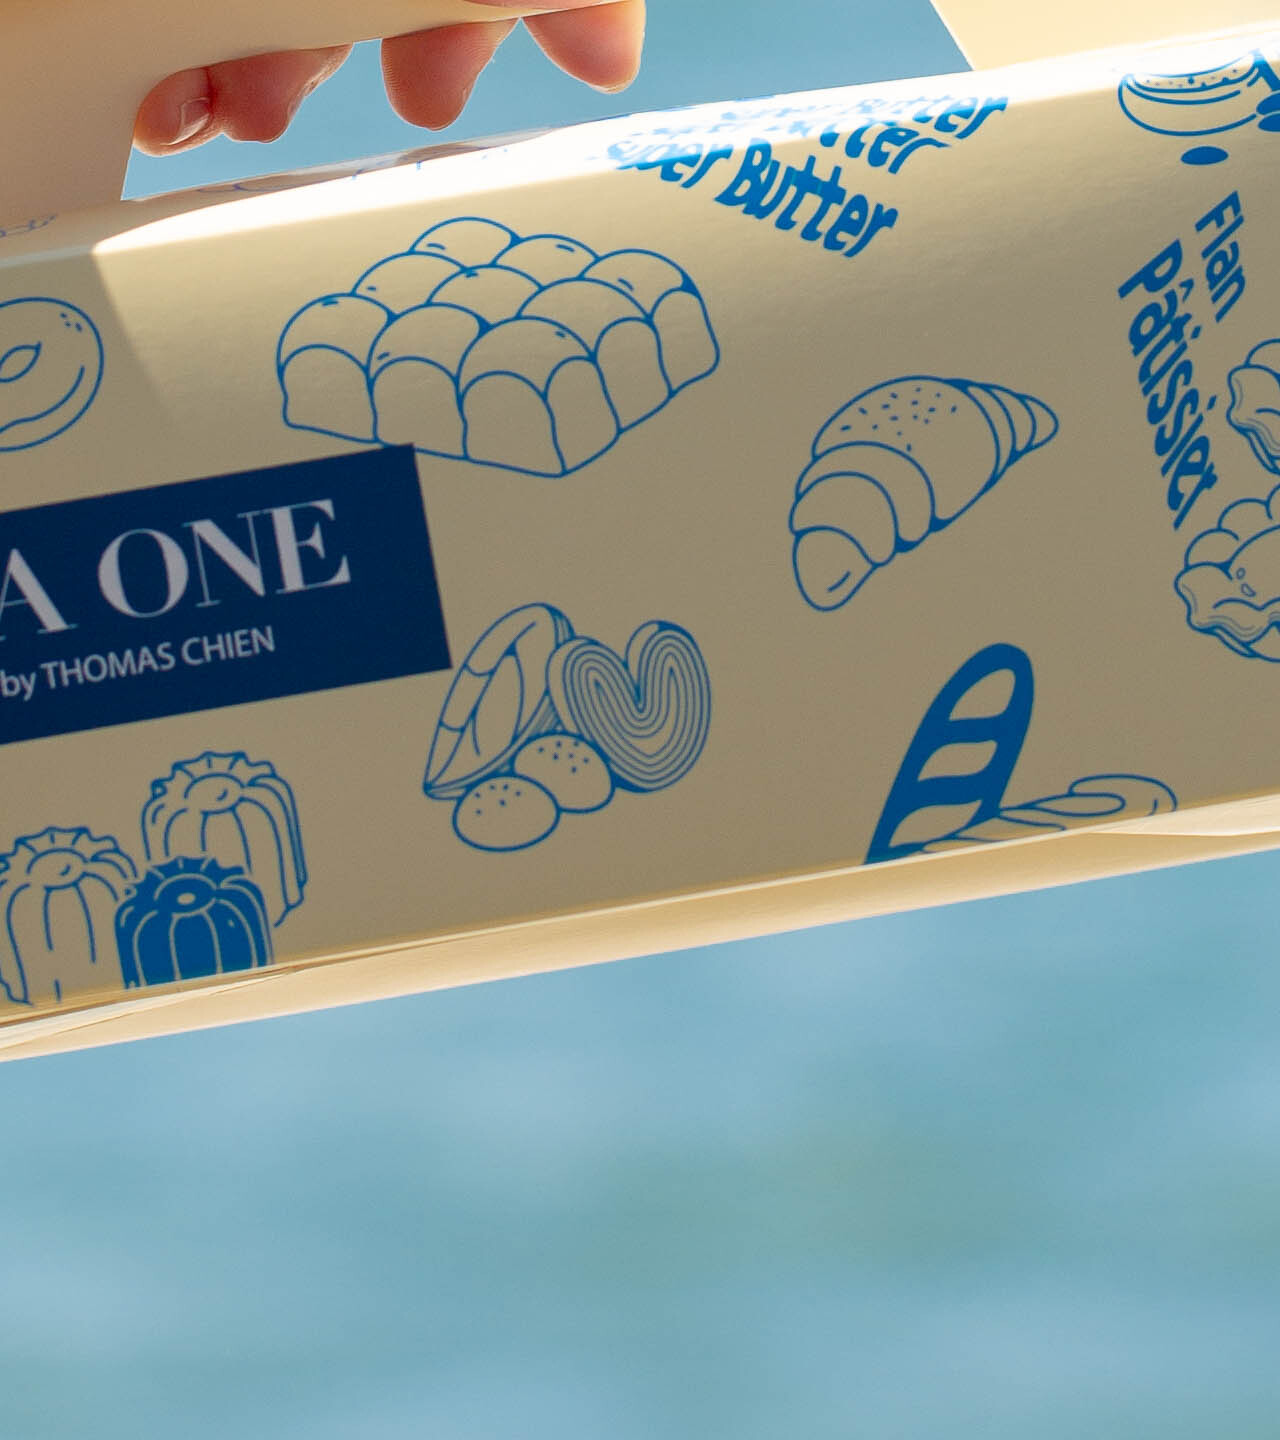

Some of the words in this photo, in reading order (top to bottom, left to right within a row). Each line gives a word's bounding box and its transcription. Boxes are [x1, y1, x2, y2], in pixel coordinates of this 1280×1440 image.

[713, 137, 899, 258] Butter
[1194, 190, 1245, 324] Flan
[1117, 238, 1218, 532] Pâtissier
[97, 498, 352, 620] ONE
[40, 641, 177, 690] THOMAS
[180, 625, 276, 667] CHIEN
